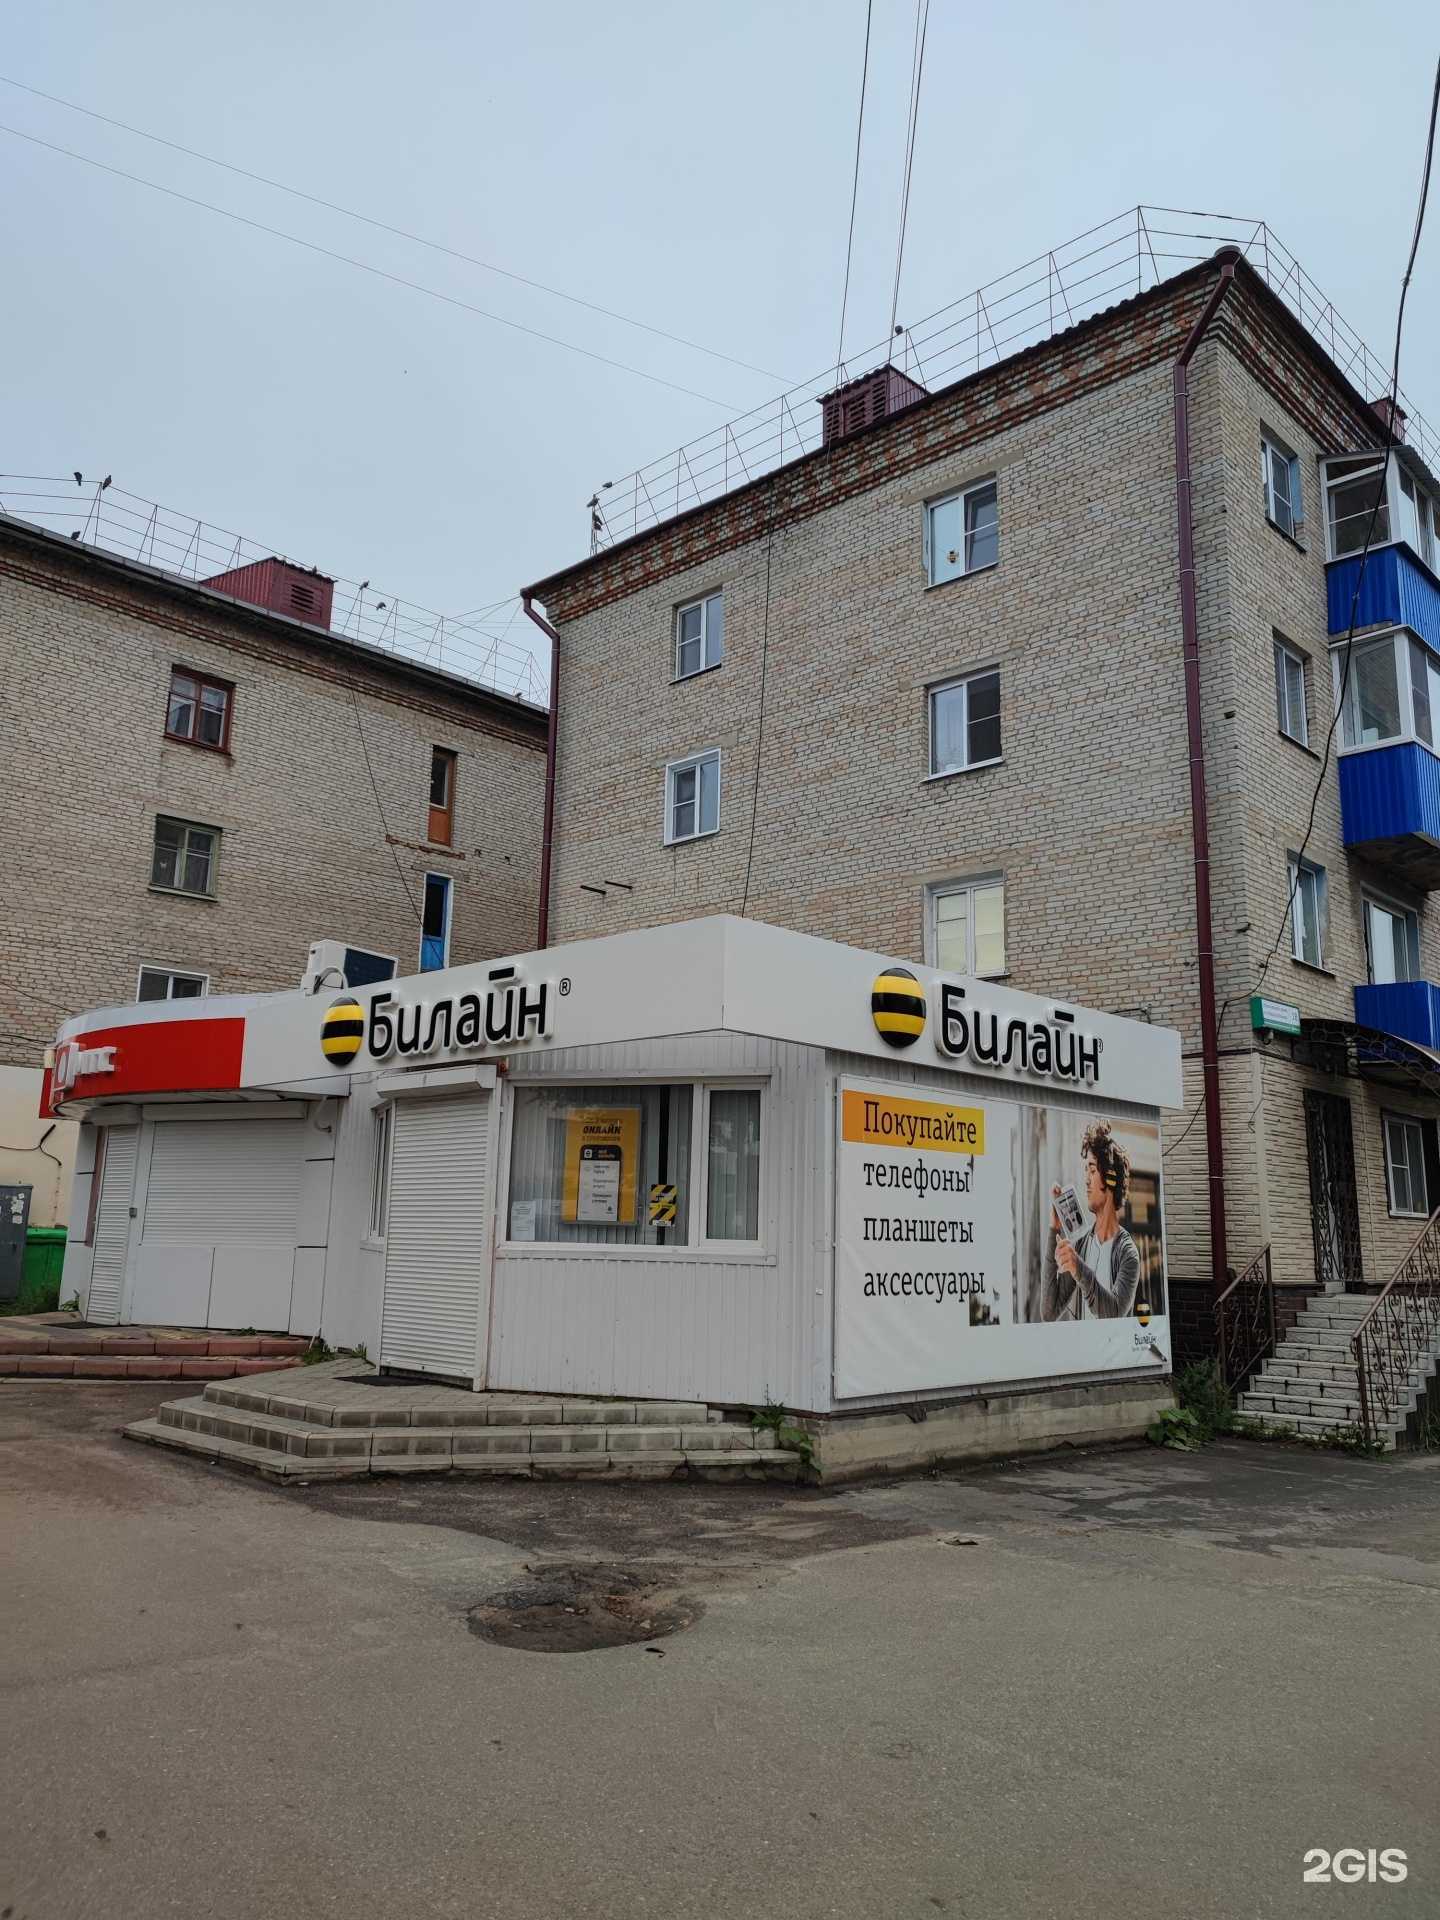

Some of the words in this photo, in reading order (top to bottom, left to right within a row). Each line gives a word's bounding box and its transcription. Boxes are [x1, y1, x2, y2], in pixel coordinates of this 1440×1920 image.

[368, 966, 548, 1058] Билайн
[941, 983, 1100, 1081] Билайн
[863, 1100, 977, 1145] Покупайте
[863, 1158, 971, 1199] телефоны
[863, 1217, 975, 1243] планшеты
[863, 1271, 986, 1303] аксессуары
